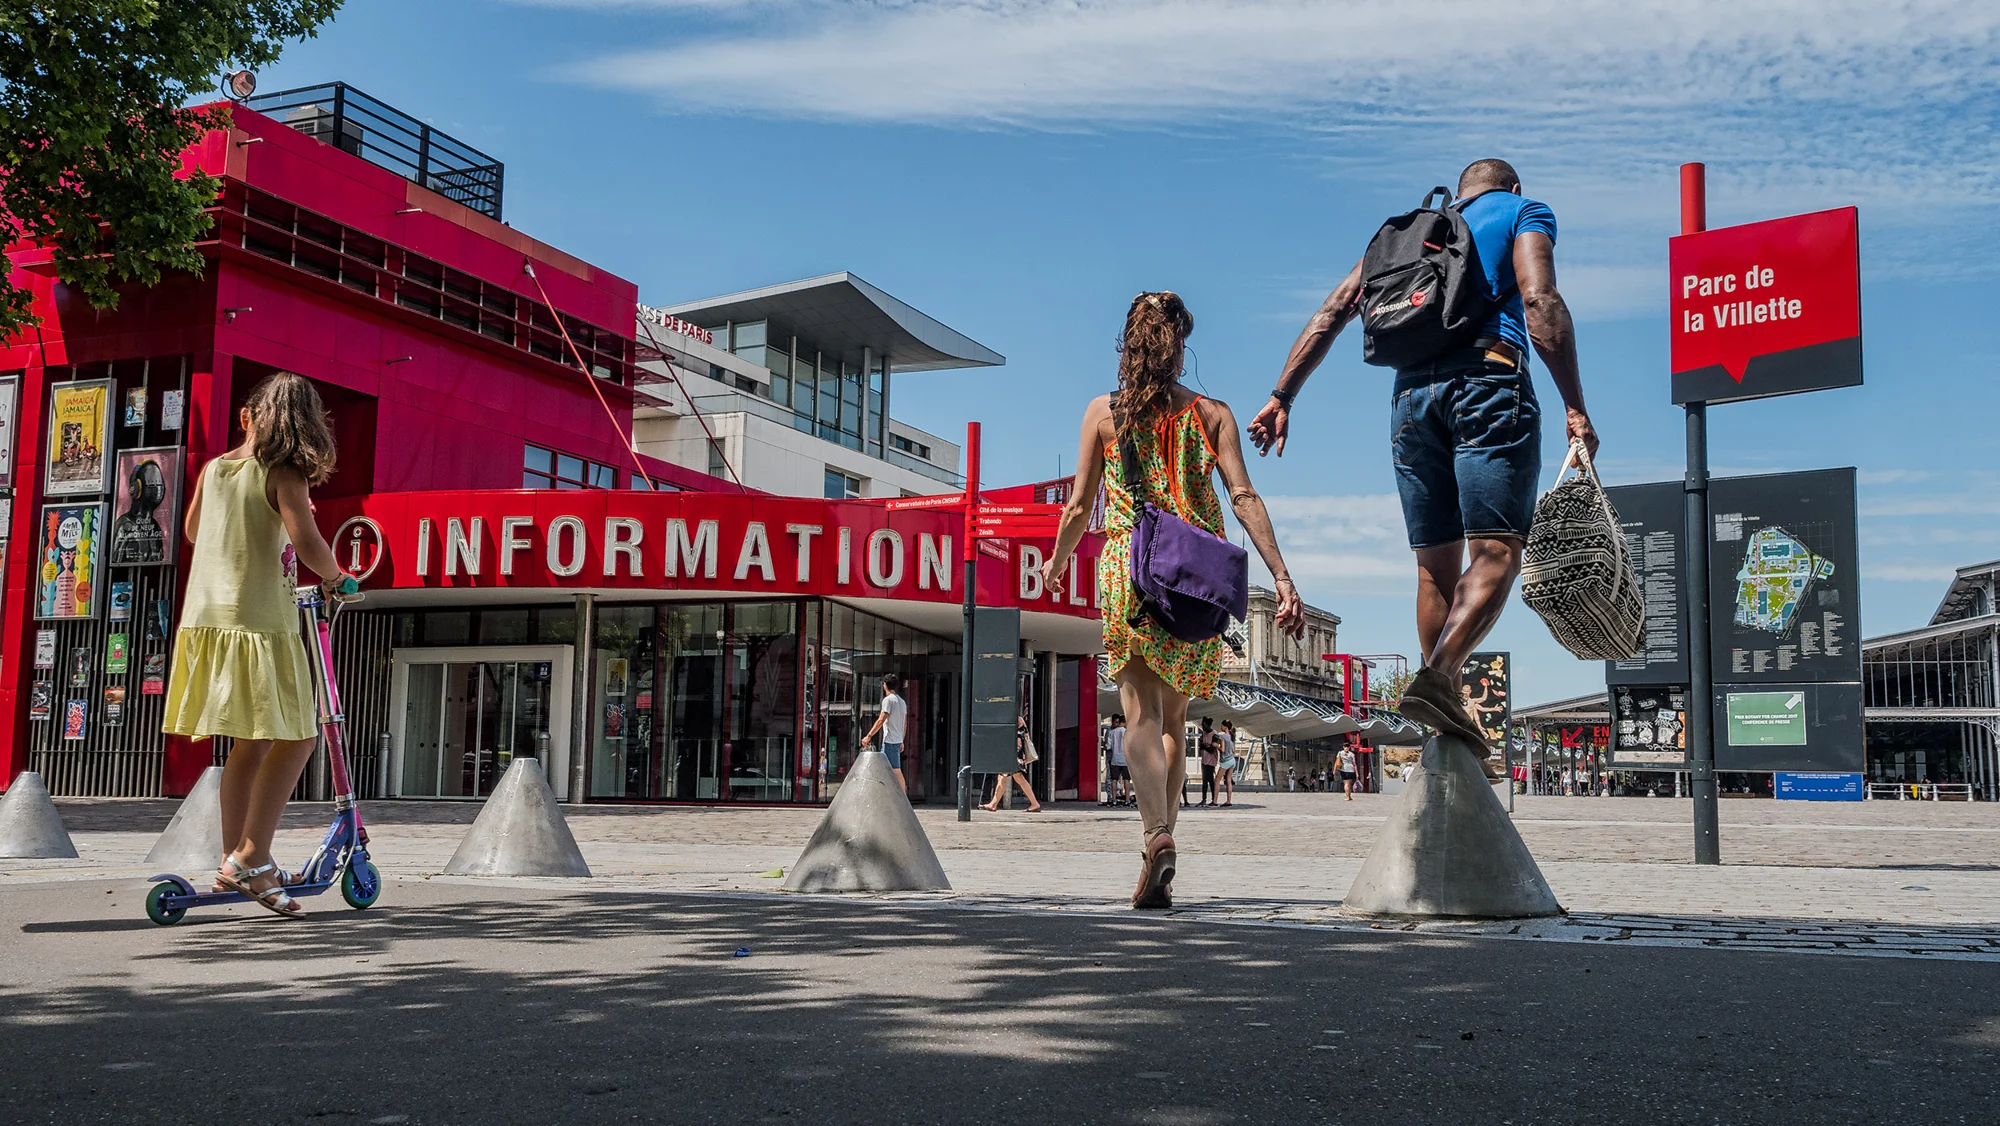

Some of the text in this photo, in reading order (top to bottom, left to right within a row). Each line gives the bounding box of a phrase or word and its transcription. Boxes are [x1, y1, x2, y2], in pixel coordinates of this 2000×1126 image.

[1683, 265, 1774, 299] Parc de
[664, 313, 680, 332] DE
[681, 319, 713, 345] PARIS
[1684, 297, 1802, 333] la Villette
[62, 405, 91, 415] JAMAICA
[65, 397, 95, 407] JAMAICA
[416, 515, 952, 591] INFORMATION
